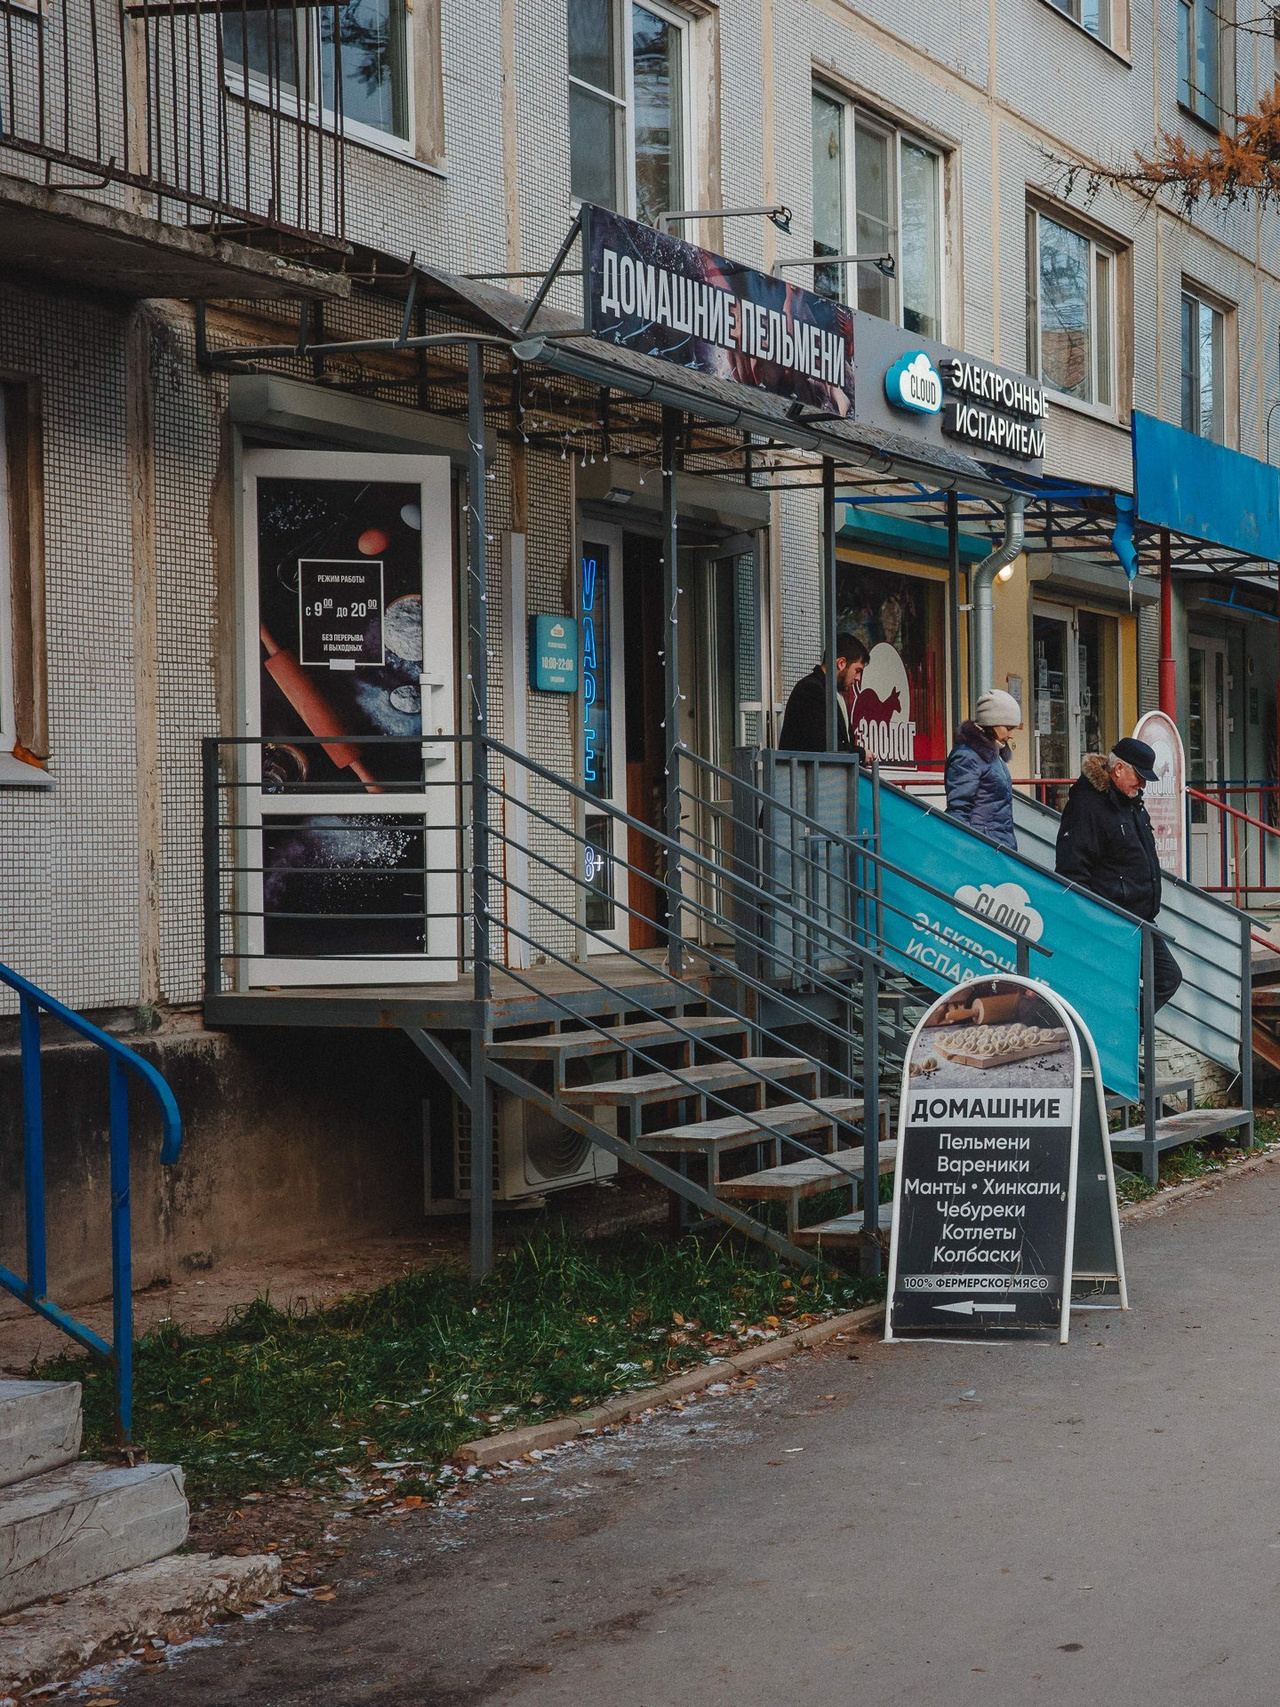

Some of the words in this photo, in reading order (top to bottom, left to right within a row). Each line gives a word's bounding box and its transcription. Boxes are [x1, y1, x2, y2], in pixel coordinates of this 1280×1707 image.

[601, 248, 736, 349] ДОМАШНИЕ
[741, 299, 845, 388] ПЕЛЬМЕНИ
[909, 372, 937, 406] CLOUD
[951, 358, 1049, 420] ЭЛЕКТРОННЫЕ
[955, 408, 1046, 459] ИСПАРИТЕЛИ
[317, 574, 340, 583] РЕЖИМ
[340, 575, 365, 583] РАБОТЫ
[321, 633, 333, 641] БЕЗ
[333, 634, 364, 642] ПЕРЕРЫВА
[328, 644, 363, 652] ВЫХОДНЫХ
[974, 892, 1031, 937] CLOUD
[905, 938, 981, 985] ИСПАР
[910, 1098, 1061, 1123] ДОМАШНИЕ
[939, 1133, 1031, 1151] Пельмени
[937, 1156, 1030, 1175] Вареники
[904, 1179, 966, 1196] Манты
[982, 1178, 1061, 1196] Хинкали
[936, 1201, 1026, 1222] Чебуреки
[942, 1224, 1016, 1241] Котлеты
[933, 1246, 1022, 1263] Колбаски
[903, 1277, 934, 1289] 100%
[935, 1277, 1012, 1289] ФЕРМЕРСКОЕ
[1012, 1278, 1049, 1290] МЯСО
